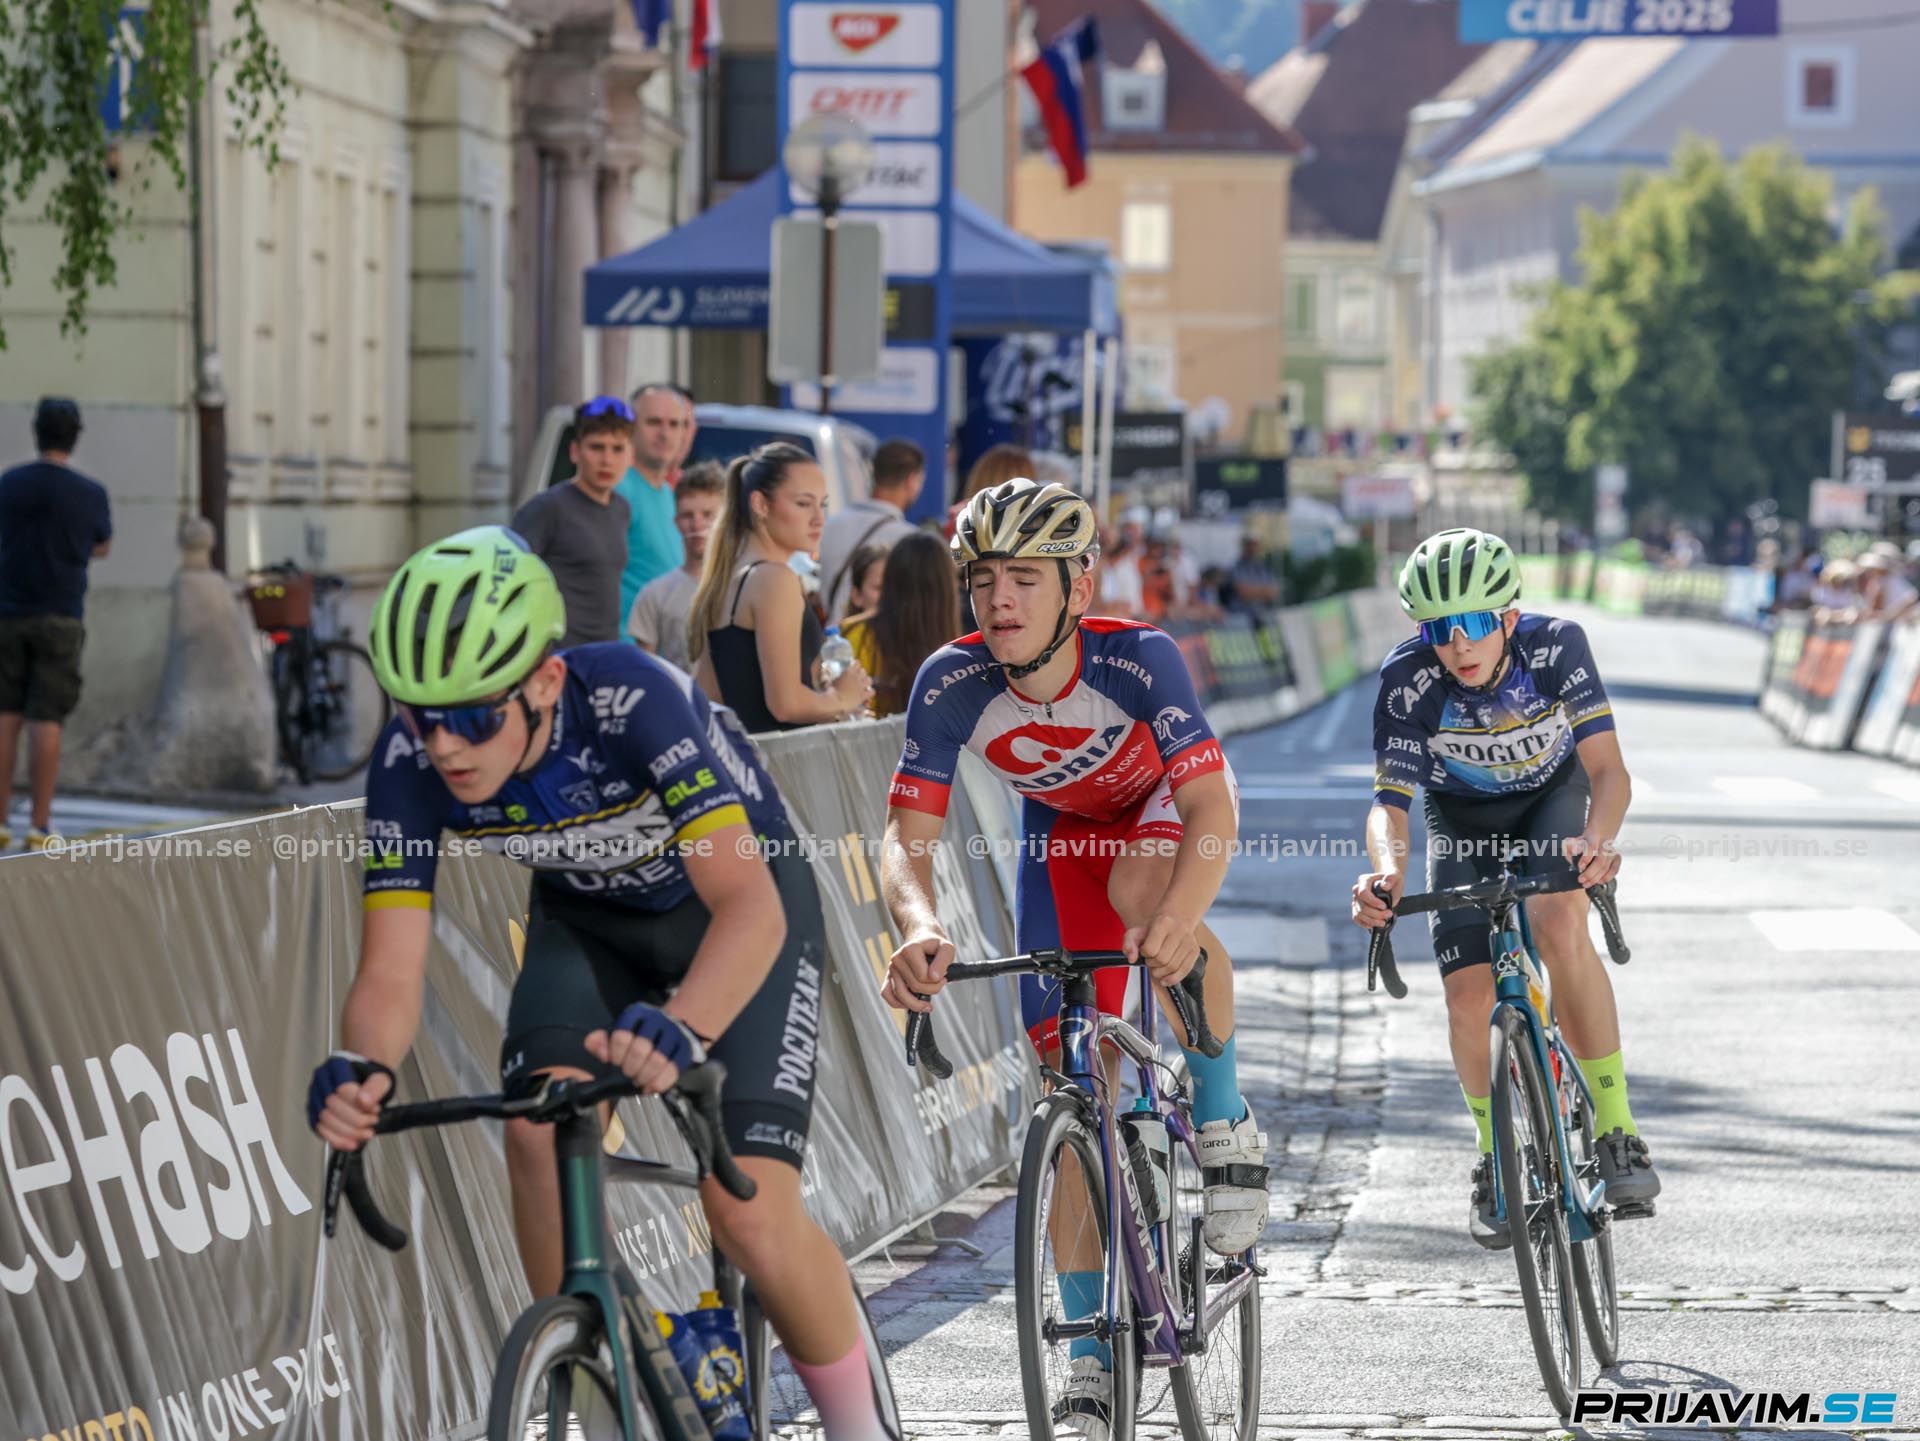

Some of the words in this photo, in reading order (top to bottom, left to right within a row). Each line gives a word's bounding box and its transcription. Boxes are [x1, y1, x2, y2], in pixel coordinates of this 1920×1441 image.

[1506, 0, 1625, 32] CELJE
[1633, 0, 1734, 32] 2025
[1036, 540, 1082, 554] RUDY
[485, 545, 516, 605] MET
[1105, 655, 1153, 690] ADRIA
[905, 762, 949, 780] Avtocenter
[1010, 723, 1127, 790] ADRIA
[1113, 740, 1146, 773] KRKA
[1168, 747, 1220, 783] OMI
[890, 781, 920, 799] ana
[1202, 1138, 1231, 1149] GIRO
[647, 1213, 681, 1270] ZA
[157, 1391, 199, 1441] IN
[201, 1367, 286, 1441] ONE
